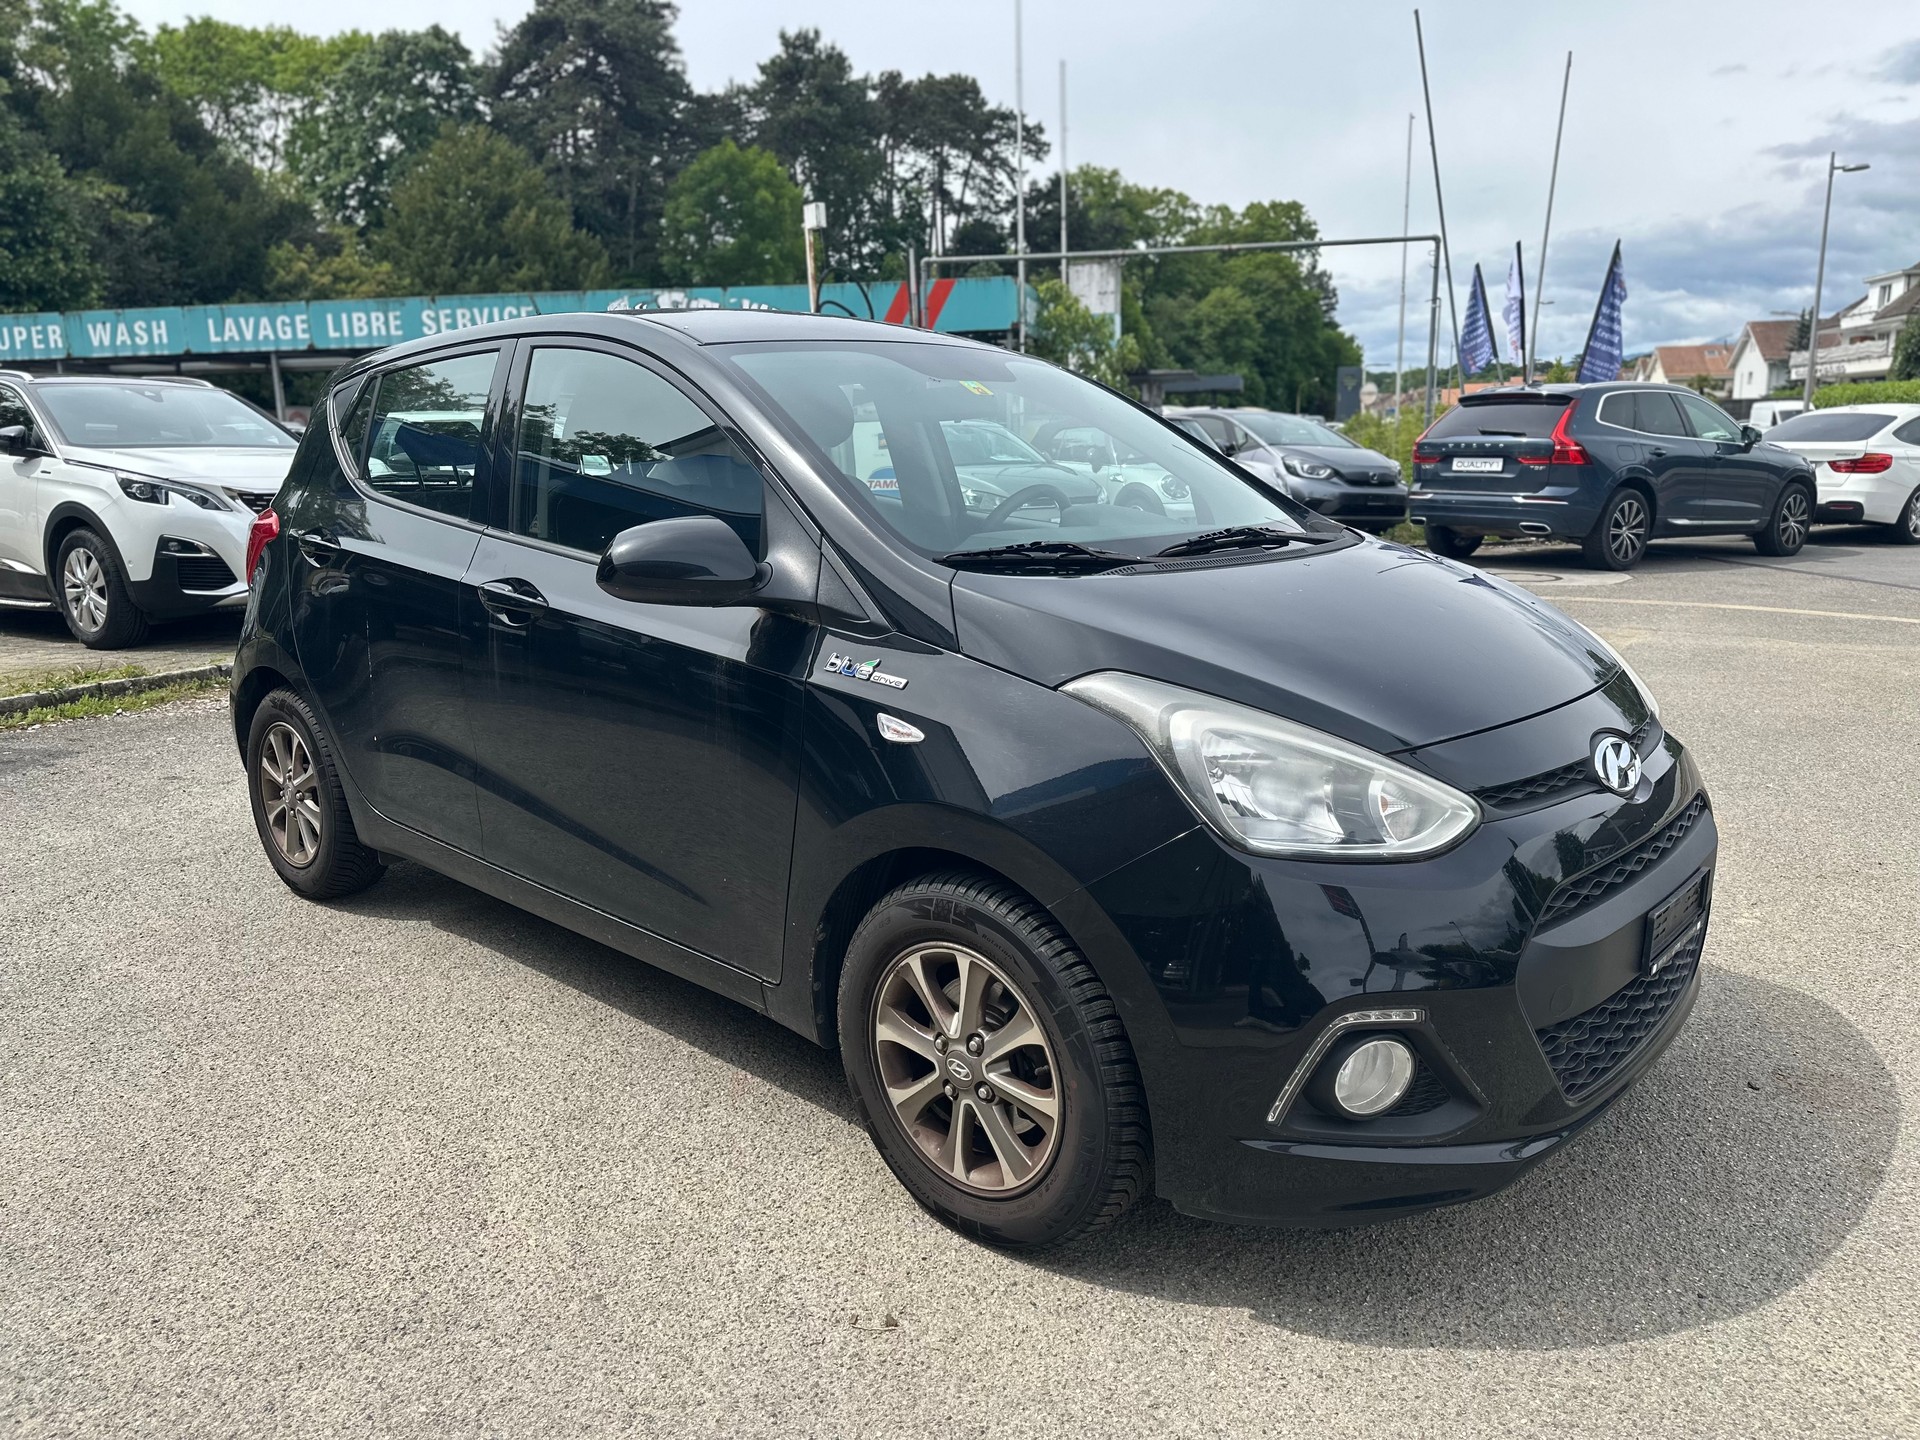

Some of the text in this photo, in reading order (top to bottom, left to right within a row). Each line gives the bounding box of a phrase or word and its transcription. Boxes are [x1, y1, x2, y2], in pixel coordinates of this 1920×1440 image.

[87, 319, 169, 347] WASH
[208, 314, 310, 343] LAVAGE
[326, 311, 404, 338] LIBRE
[1456, 461, 1494, 469] QUALITY
[823, 652, 903, 687] blue drive
